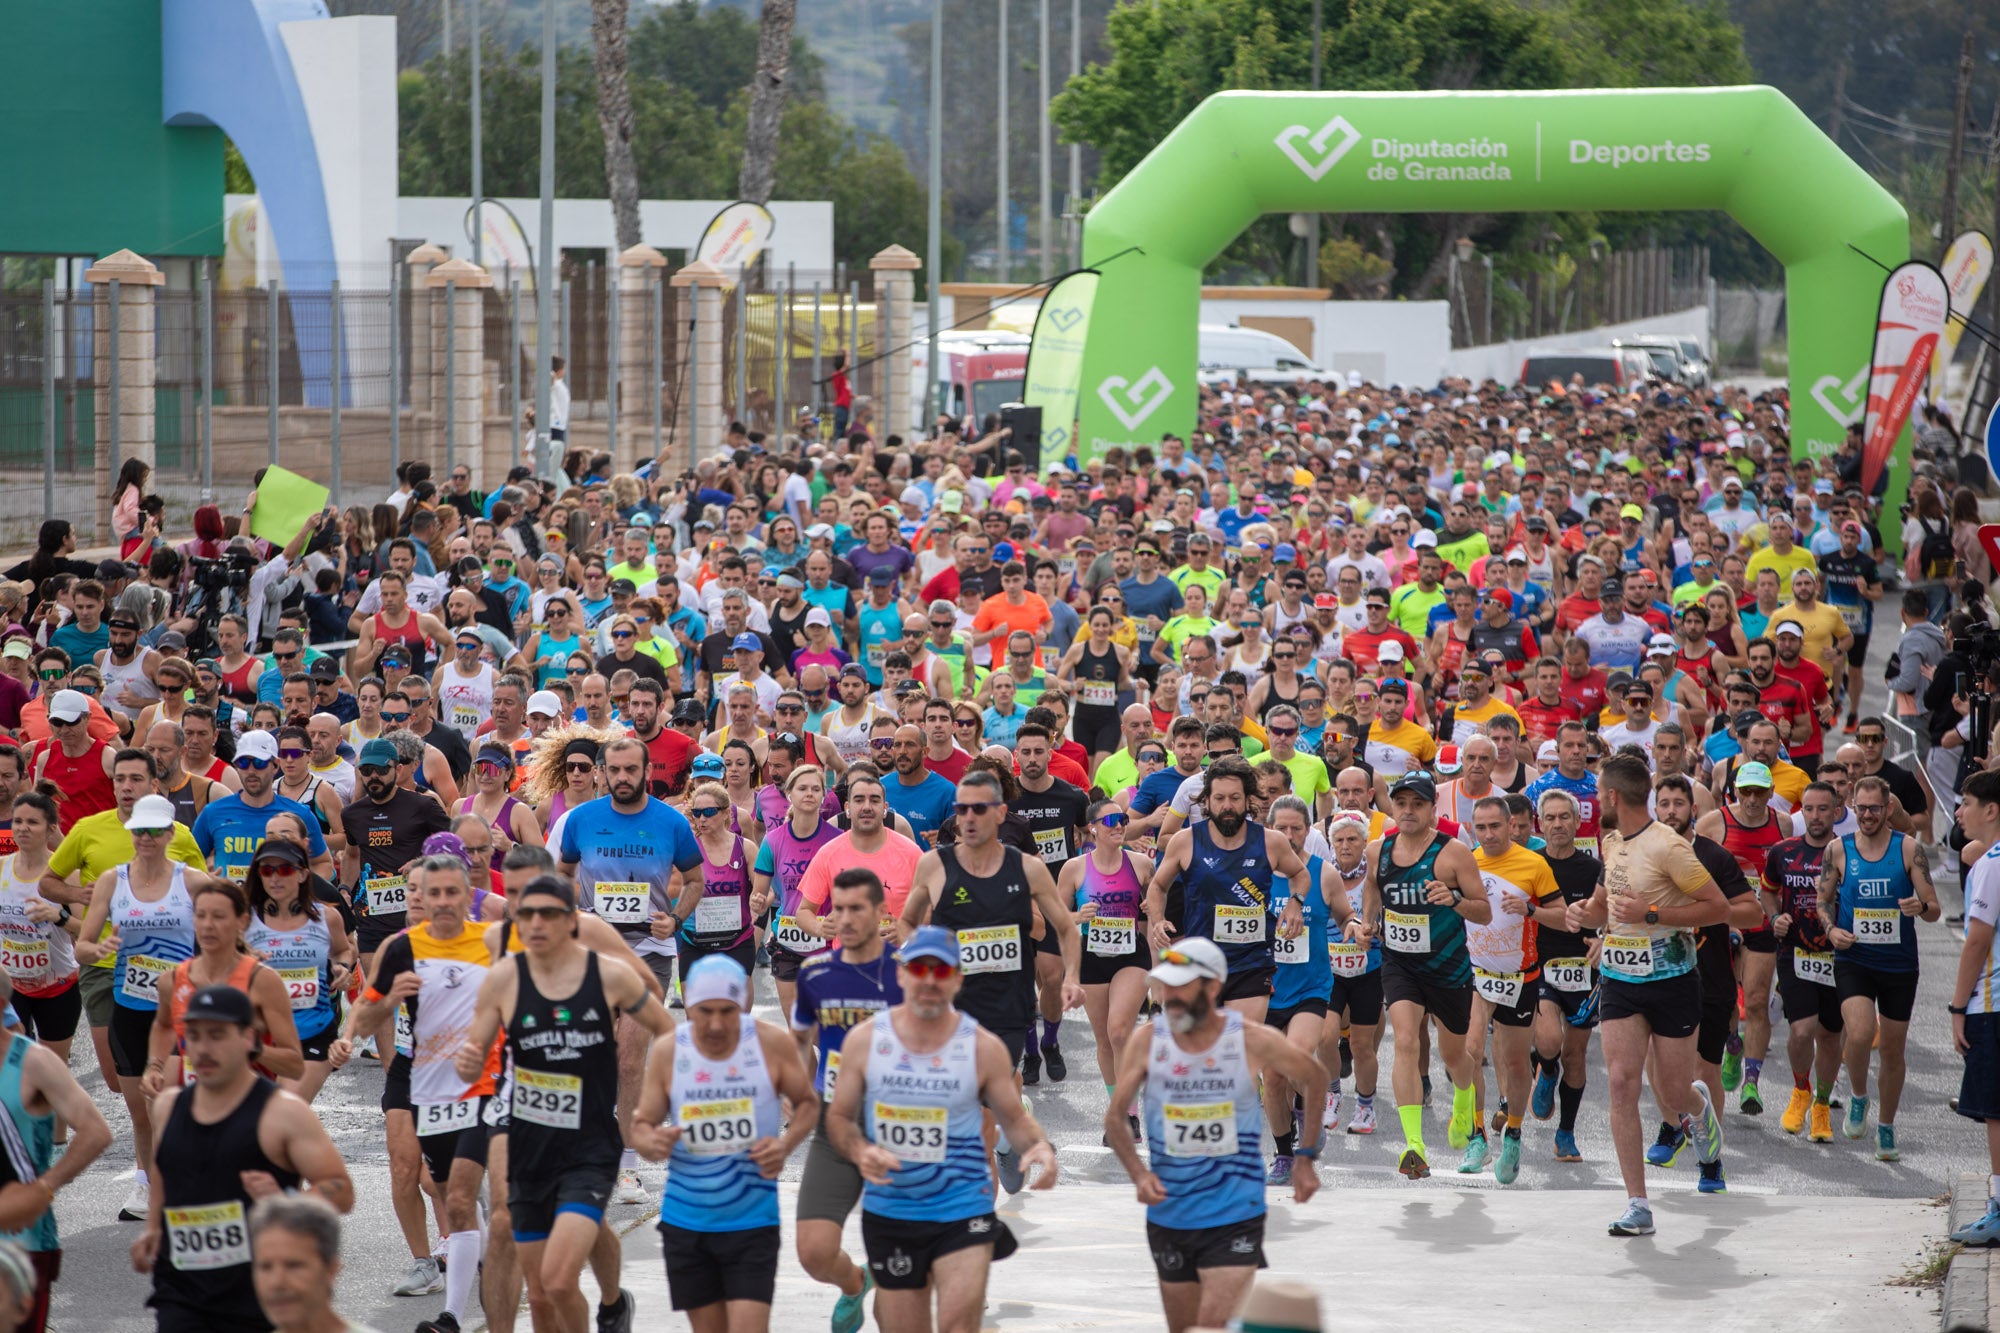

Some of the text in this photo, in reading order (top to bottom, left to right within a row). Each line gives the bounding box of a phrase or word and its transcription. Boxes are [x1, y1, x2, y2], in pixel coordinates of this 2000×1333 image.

[1371, 136, 1508, 162] Diputación
[1569, 138, 1711, 168] Deportes
[1367, 162, 1512, 182] de Granada
[1085, 688, 1114, 699] 2131
[453, 713, 478, 726] 308
[1018, 807, 1061, 816] BLACK BOX
[368, 830, 393, 838] FONDO
[368, 837, 393, 847] 2025
[1784, 874, 1815, 888] PIRA
[373, 888, 406, 907] 748
[602, 896, 641, 913] 732
[119, 918, 182, 928] MARACENA
[1223, 918, 1259, 934] 139
[1860, 920, 1893, 934] 338
[1090, 928, 1132, 945] 3321
[1389, 924, 1421, 943] 339
[2, 949, 49, 970] 2106
[961, 941, 1018, 964] 3008
[1603, 948, 1652, 966] 1024
[1551, 968, 1584, 982] 708
[1801, 959, 1832, 976] 892
[1482, 978, 1516, 997] 492
[881, 1074, 960, 1092] MARACENA
[1163, 1078, 1235, 1093] MARACENA
[516, 1085, 577, 1114] 3292
[428, 1101, 469, 1124] 513
[682, 1118, 752, 1144] 1030
[877, 1122, 943, 1148] 1033
[1174, 1122, 1224, 1144] 749
[174, 1224, 244, 1252] 3068
